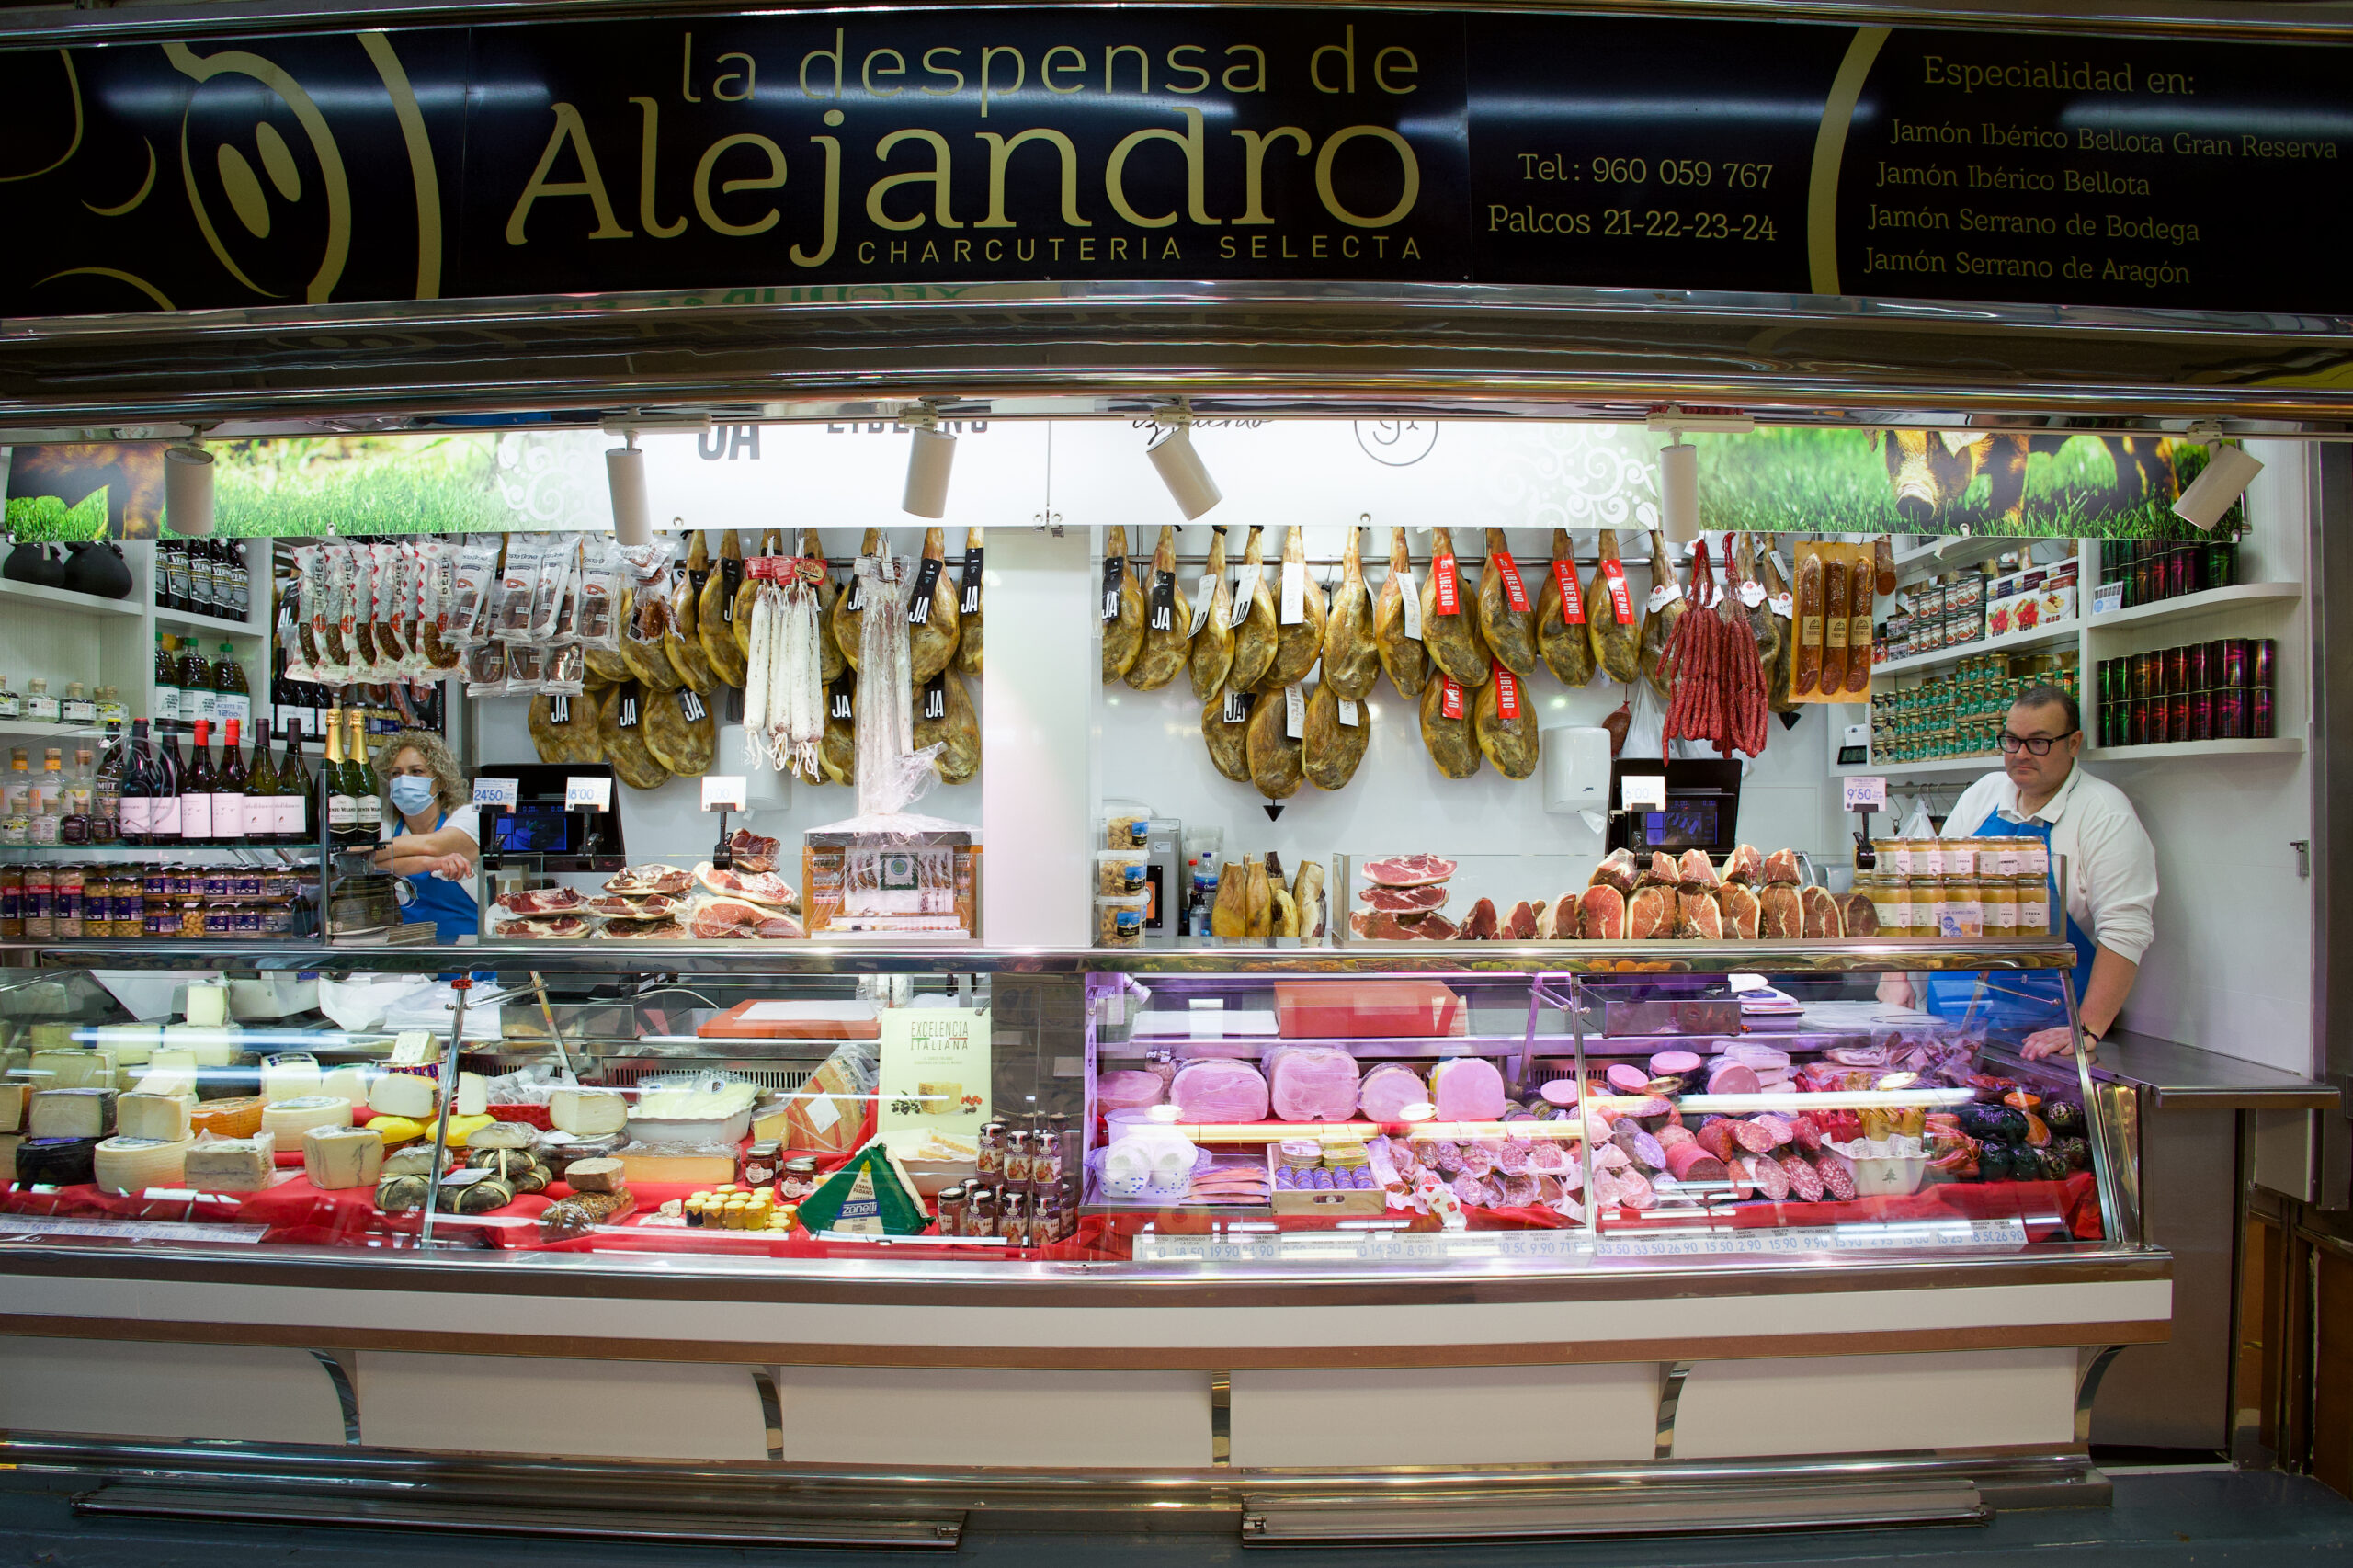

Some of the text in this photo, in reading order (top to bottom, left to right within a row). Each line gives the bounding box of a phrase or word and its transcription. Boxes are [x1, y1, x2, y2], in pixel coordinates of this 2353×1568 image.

[683, 24, 1419, 118] la despensa de
[1924, 55, 2196, 96] Especialidad en:
[1891, 119, 2337, 160] Jamón Ibérico Bellota Gran Reserva
[506, 97, 1421, 268] Alejandro
[1592, 157, 1647, 184] 960
[1659, 159, 1711, 187] 059
[1722, 163, 1773, 189] 767
[1876, 162, 2151, 196] Jamón Ibérico Bellota
[1488, 204, 1779, 241] Palcos 21-22-23-24
[1868, 204, 2200, 246] Jamón Serrano de Bodega
[858, 235, 1422, 264] CHARCUTERIA SELECTA
[1863, 247, 2191, 288] Jamón Serrano de Aragón
[961, 585, 979, 614] JA
[1438, 571, 1454, 606] LIBERNO
[1503, 569, 1525, 603] LIBERNO
[1561, 576, 1580, 614] LIBERNO
[909, 597, 929, 624] JA
[1102, 591, 1118, 619] JA
[1152, 606, 1171, 631] JA
[1232, 601, 1249, 625] JA
[925, 690, 945, 719] JA
[1498, 671, 1515, 709] LIBERNO
[551, 696, 569, 723] JA
[619, 698, 637, 727] JA
[684, 691, 706, 722] JA
[831, 694, 852, 719] JA
[473, 789, 503, 801] 24'50
[1847, 788, 1871, 801] 9'50
[911, 1021, 969, 1038] EXCELENCIA
[910, 1040, 969, 1051] ITALIANA
[842, 1202, 878, 1216] zanetti
